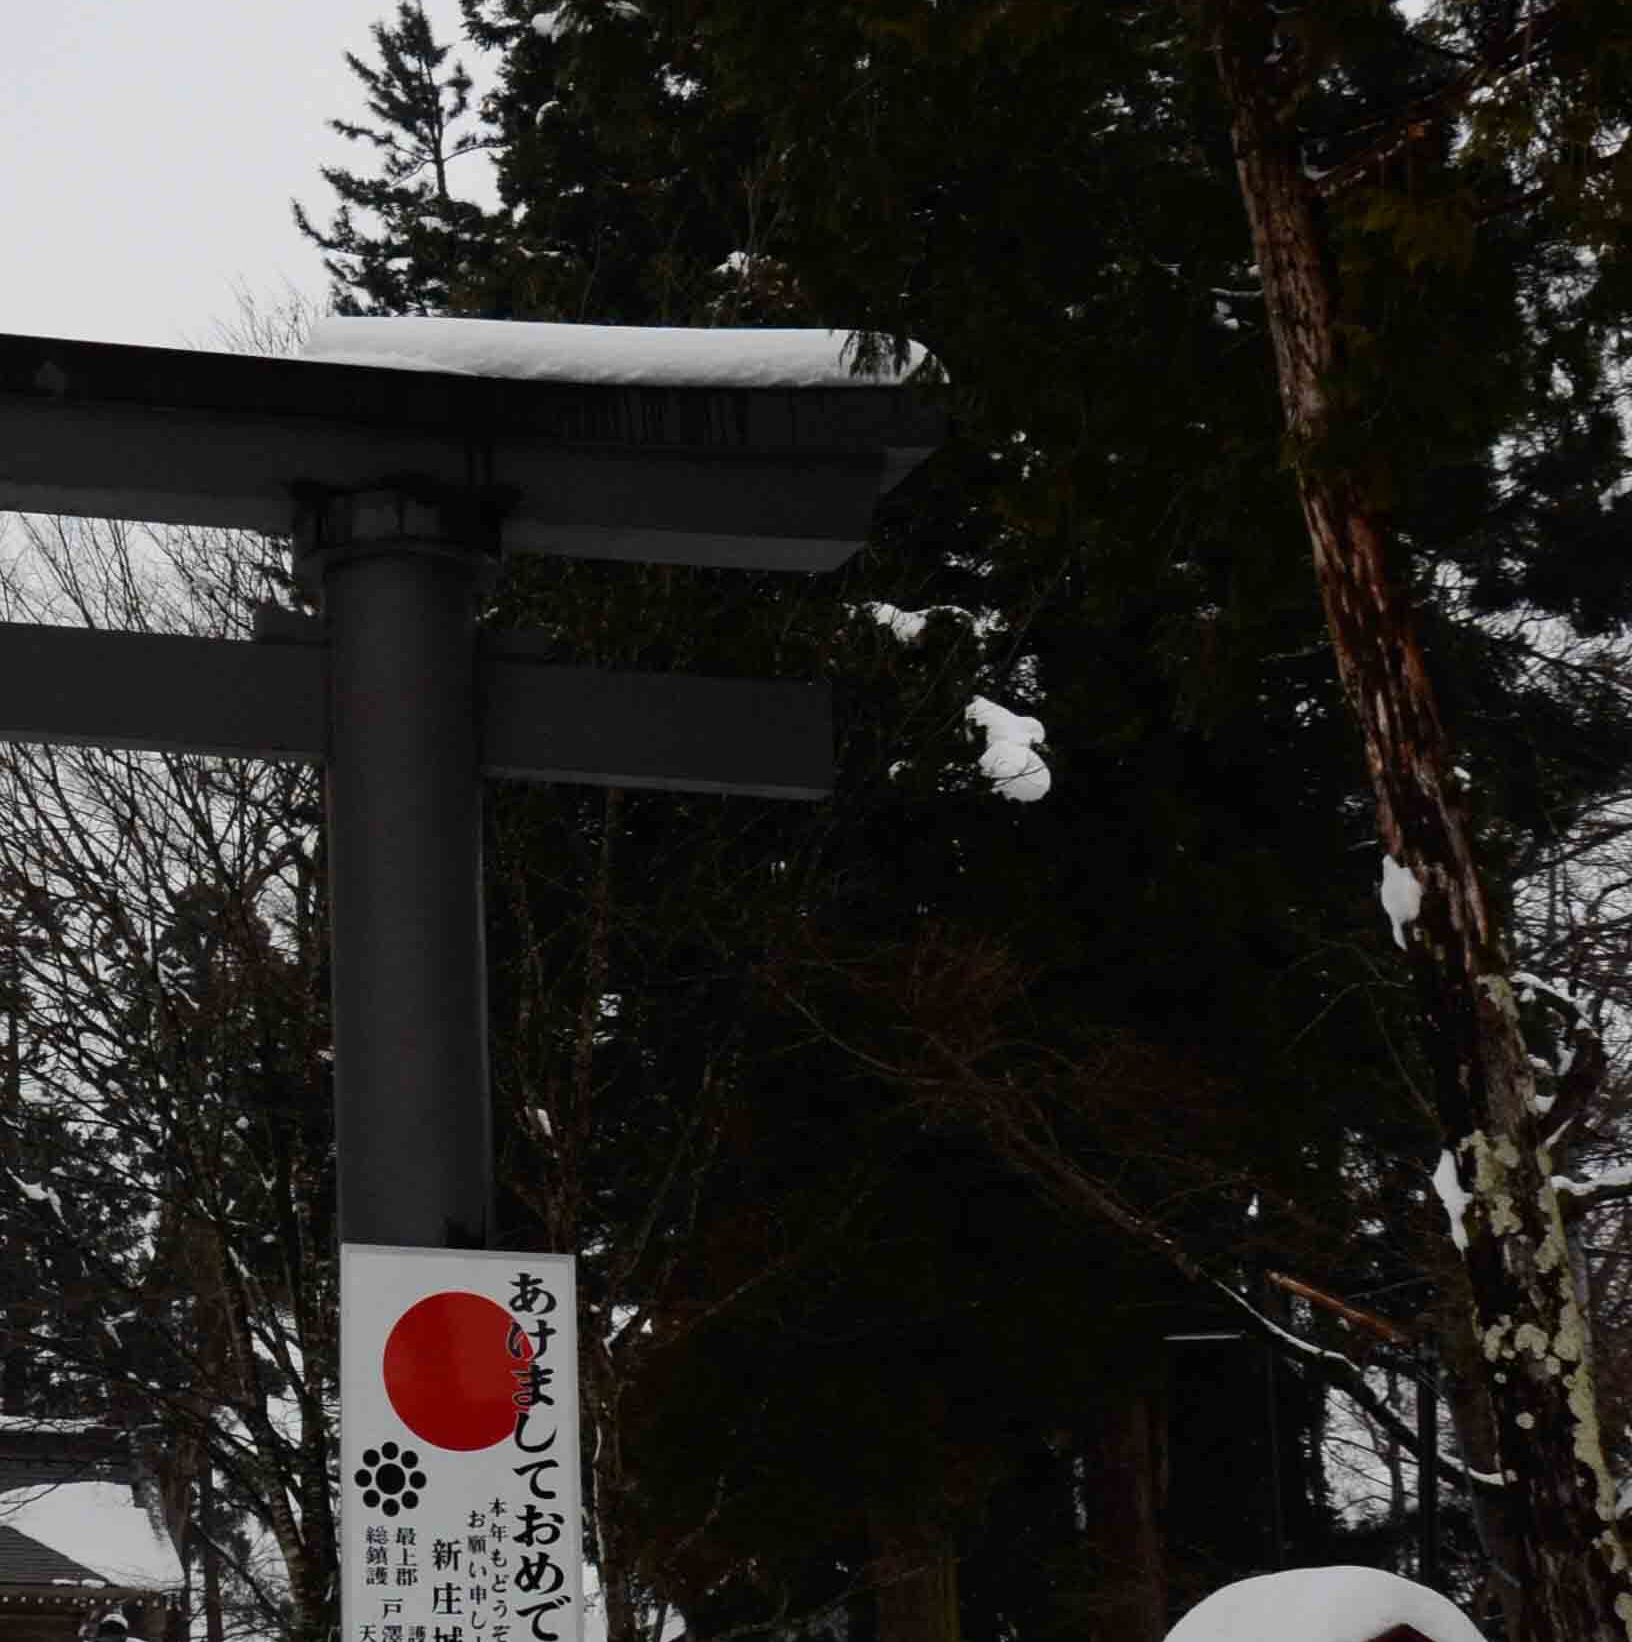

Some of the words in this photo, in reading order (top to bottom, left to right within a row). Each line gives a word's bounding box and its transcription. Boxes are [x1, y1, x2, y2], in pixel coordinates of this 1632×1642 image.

[365, 1525, 389, 1586] 総鎮護
[395, 1527, 418, 1586] 最上郡
